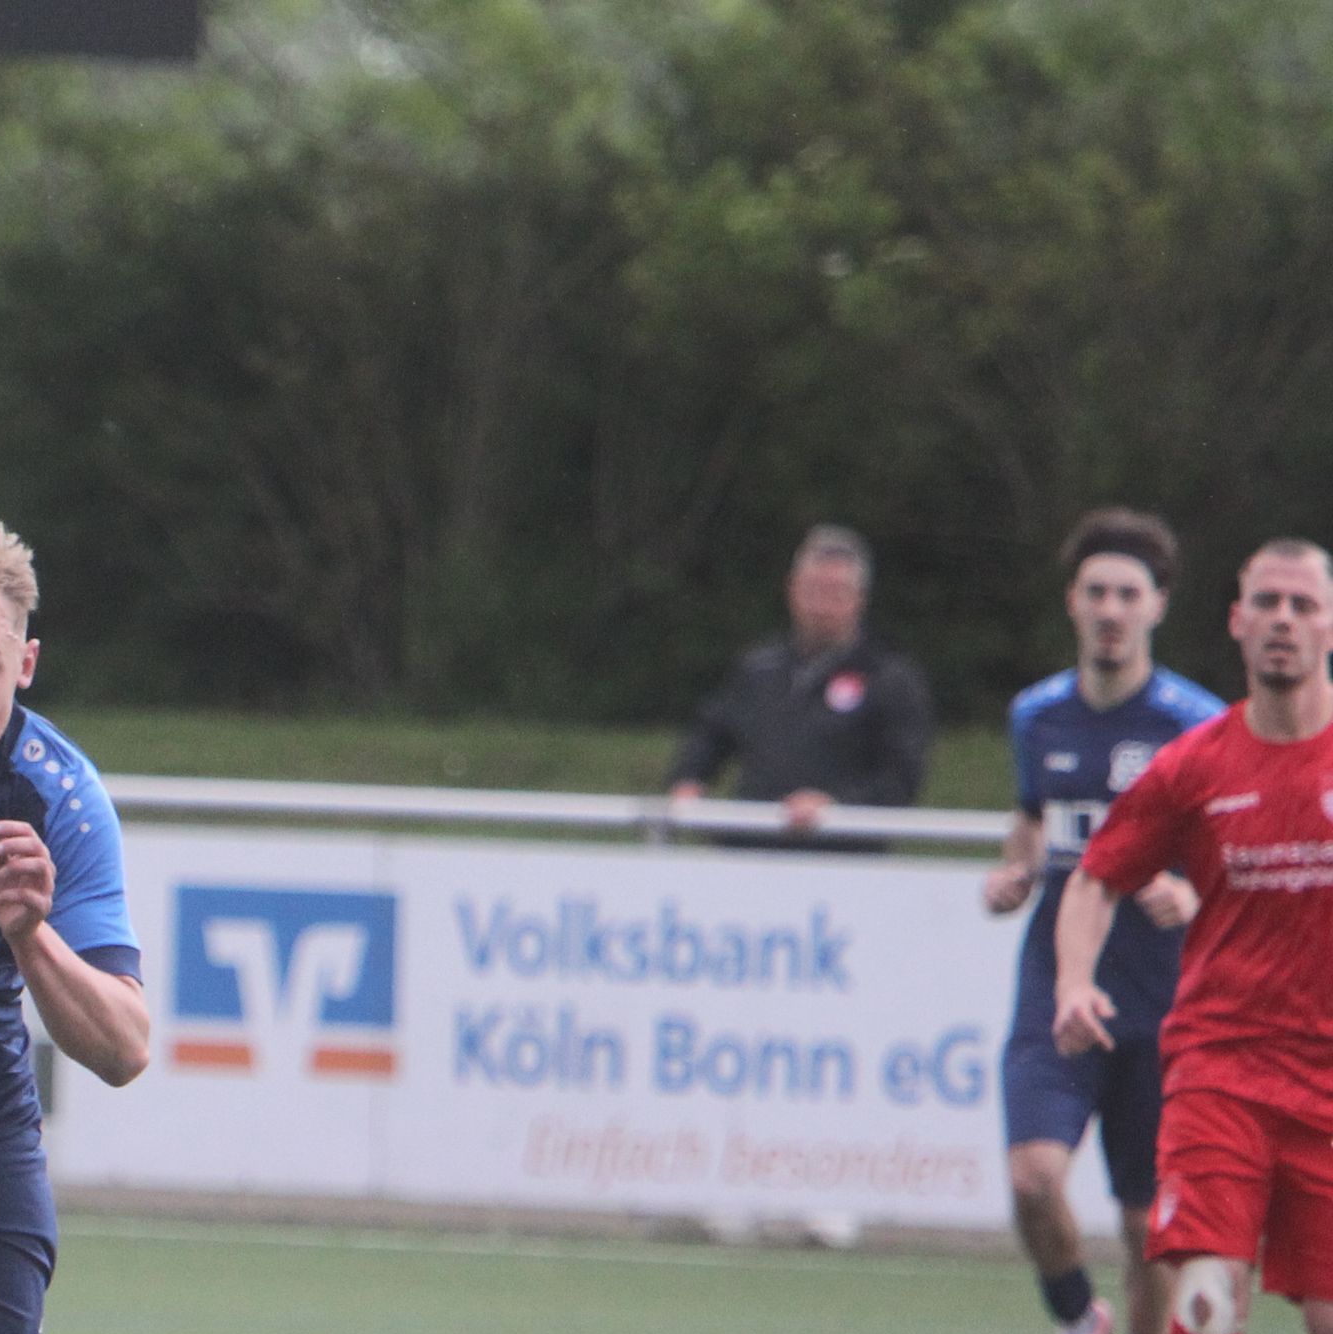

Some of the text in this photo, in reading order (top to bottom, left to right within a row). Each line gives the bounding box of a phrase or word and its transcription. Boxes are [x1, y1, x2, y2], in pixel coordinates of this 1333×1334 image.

[452, 894, 853, 991] Volksbank
[452, 999, 988, 1105] Köln Bonn eG
